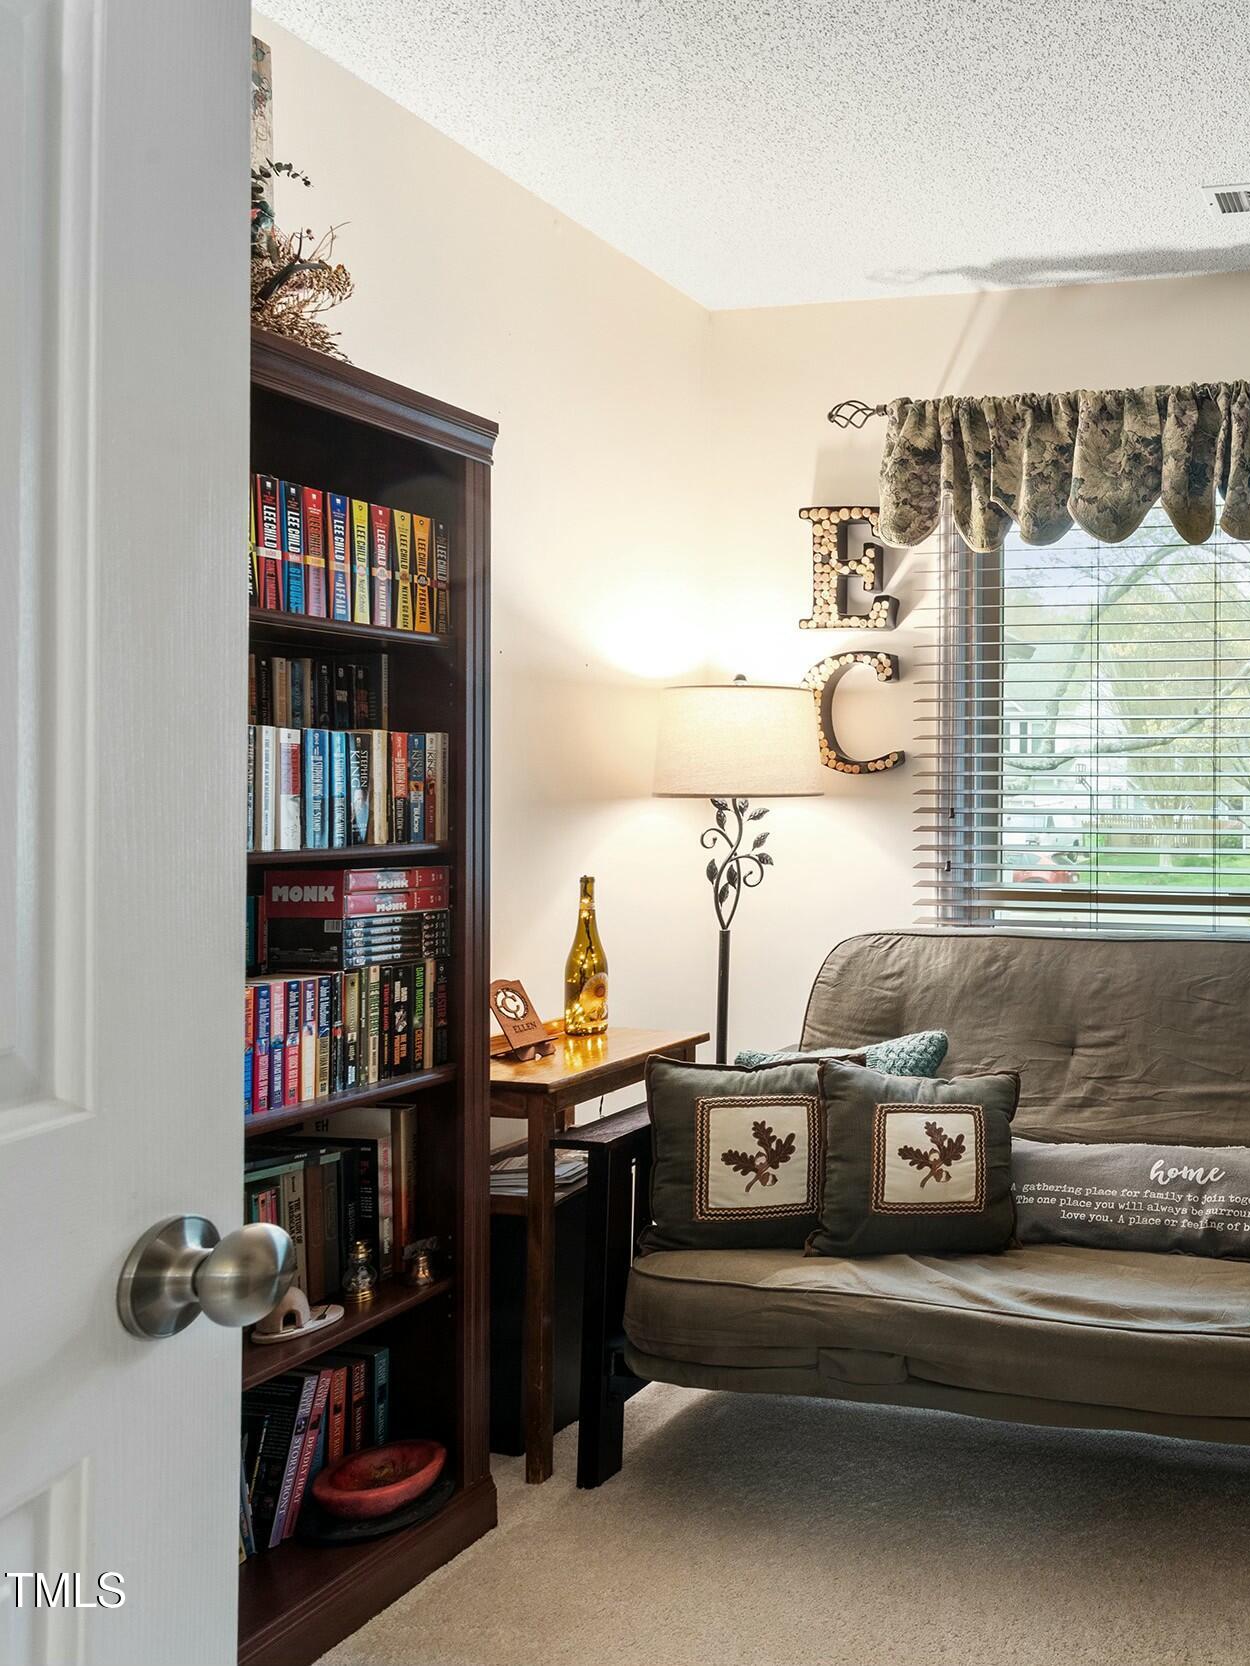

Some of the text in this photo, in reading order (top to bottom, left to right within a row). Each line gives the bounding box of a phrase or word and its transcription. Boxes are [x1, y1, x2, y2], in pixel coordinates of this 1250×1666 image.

[264, 506, 275, 522] LEE
[264, 523, 277, 548] CHILD
[308, 515, 321, 556] LEE CHILD
[334, 519, 344, 535] LEE
[356, 525, 364, 539] LEE
[377, 529, 386, 543] LEE
[335, 537, 344, 560] CHILD
[357, 540, 365, 562] CHILD
[400, 534, 408, 549] LEE
[418, 538, 426, 552] LEE
[288, 511, 302, 609] LEE CHILD 61 HOURS
[378, 544, 386, 566] CHILD
[418, 553, 426, 572] CHILD
[437, 545, 446, 581] LEE CHILD
[799, 506, 900, 631] E
[336, 582, 346, 614] AFFAIR
[801, 650, 905, 774] C
[313, 762, 323, 783] STEPHEN
[350, 750, 360, 788] KING
[360, 750, 368, 787] STEPHEN
[313, 813, 321, 832] STAND
[335, 822, 344, 837] WALK
[272, 885, 335, 902] MONK
[378, 879, 408, 889] MONK
[376, 902, 407, 912] MONK
[415, 967, 423, 987] DAVID
[289, 991, 298, 1003] John
[320, 986, 329, 996] John
[259, 998, 268, 1008] John
[370, 994, 379, 1014] GREEN
[415, 988, 423, 1018] MORRELL
[289, 1008, 298, 1033] MacDonald
[319, 1002, 329, 1026] MacDonald
[259, 1013, 269, 1038] MacDonald
[513, 1022, 536, 1033] ELLEN
[320, 1038, 328, 1055] DARKER
[259, 1056, 268, 1080] NIGHTMARE
[320, 1055, 329, 1066] THAN
[259, 1086, 268, 1097] PINK
[1150, 1159, 1225, 1185] home
[1011, 1183, 1016, 1191] A
[1022, 1183, 1082, 1195] gathering
[1085, 1187, 1117, 1196] place
[1120, 1188, 1140, 1197] for
[1143, 1190, 1183, 1202] family
[1187, 1193, 1199, 1202] to
[1201, 1194, 1225, 1205] join
[1016, 1195, 1034, 1204] The
[1037, 1196, 1056, 1204] one
[1059, 1198, 1092, 1208] place
[1094, 1201, 1114, 1210] you
[1118, 1202, 1144, 1211] will
[1147, 1203, 1188, 1215] always
[1191, 1207, 1203, 1216] be
[295, 1213, 303, 1234] STUDY
[1060, 1210, 1086, 1220] love
[1088, 1213, 1113, 1223] you.
[1117, 1215, 1125, 1223] A
[1128, 1215, 1161, 1226] place
[1164, 1218, 1178, 1227] or
[1180, 1219, 1224, 1231] feeling
[1227, 1223, 1240, 1231] of
[278, 1438, 301, 1515] STORM FRONT
[294, 1437, 314, 1504] DEADLY HEAT
